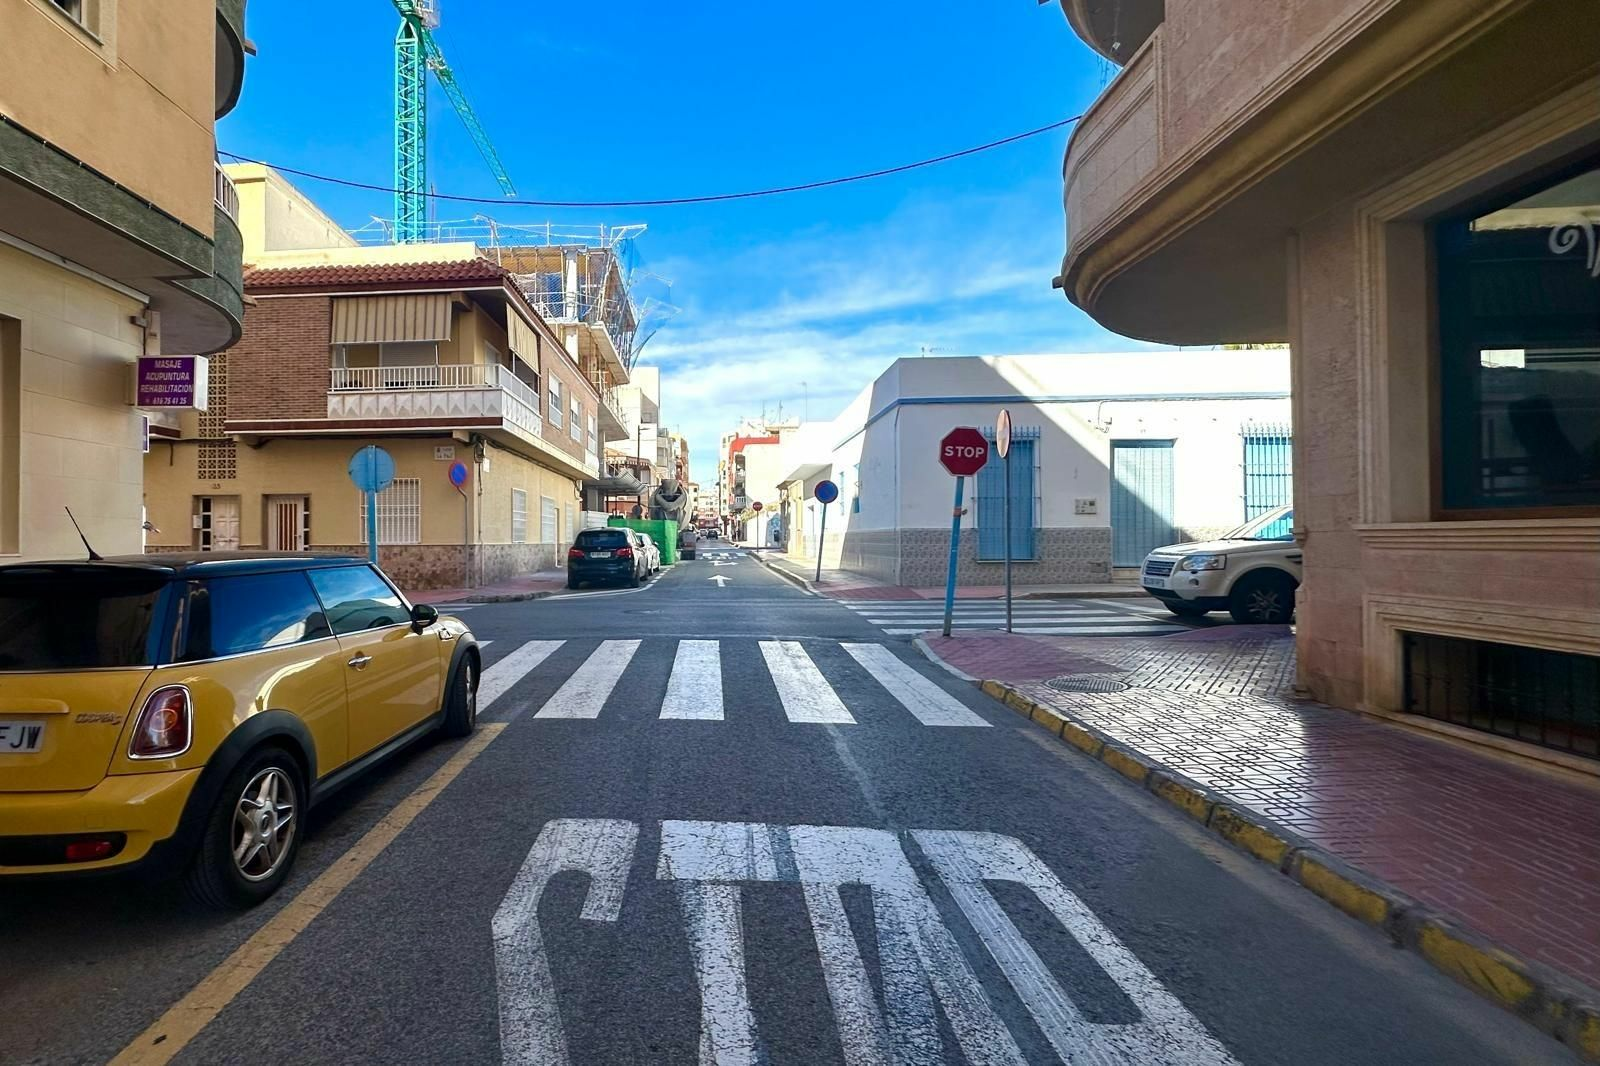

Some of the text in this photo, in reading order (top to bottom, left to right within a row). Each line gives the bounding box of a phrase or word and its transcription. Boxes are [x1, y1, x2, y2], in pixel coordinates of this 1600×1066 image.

[154, 360, 182, 368] MASAJE
[145, 372, 190, 380] ACUPUNTURA
[944, 445, 985, 458] STOP
